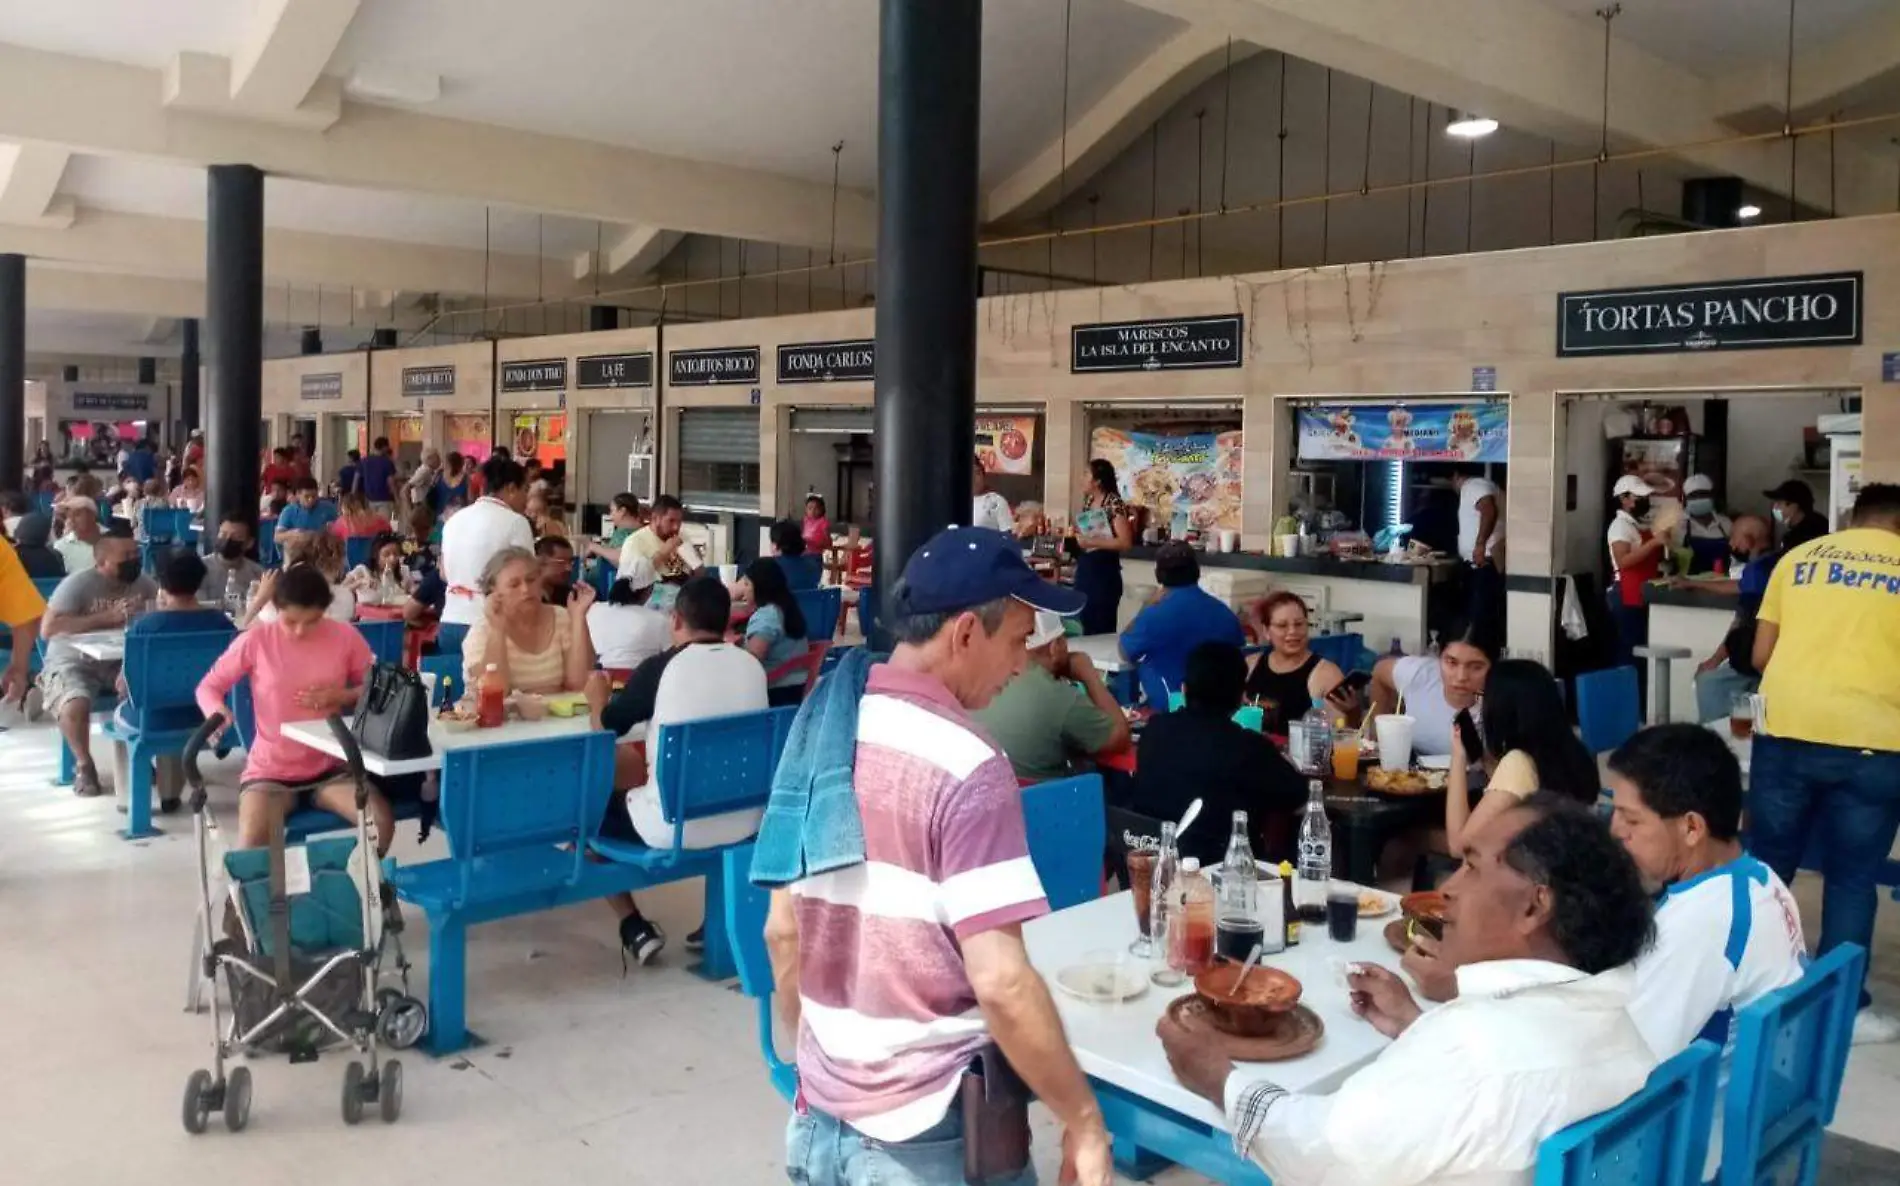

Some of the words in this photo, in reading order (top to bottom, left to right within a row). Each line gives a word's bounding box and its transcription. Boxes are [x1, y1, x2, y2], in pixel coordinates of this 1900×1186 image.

[1579, 302, 1694, 332] TORTAS
[1704, 293, 1837, 326] PANCHO
[1117, 326, 1189, 341] MARISCOS
[1081, 345, 1097, 357] LA
[1101, 343, 1129, 356] ISLA
[1133, 342, 1155, 354] DEL
[1161, 338, 1230, 353] ENCANTO
[602, 364, 613, 377] LA
[614, 363, 625, 376] FE
[674, 357, 724, 373] ANTOJITOS
[725, 355, 755, 371] ROCIO
[788, 353, 824, 370] FONDA
[827, 351, 873, 368] CARLOS
[1793, 561, 1818, 586] El
